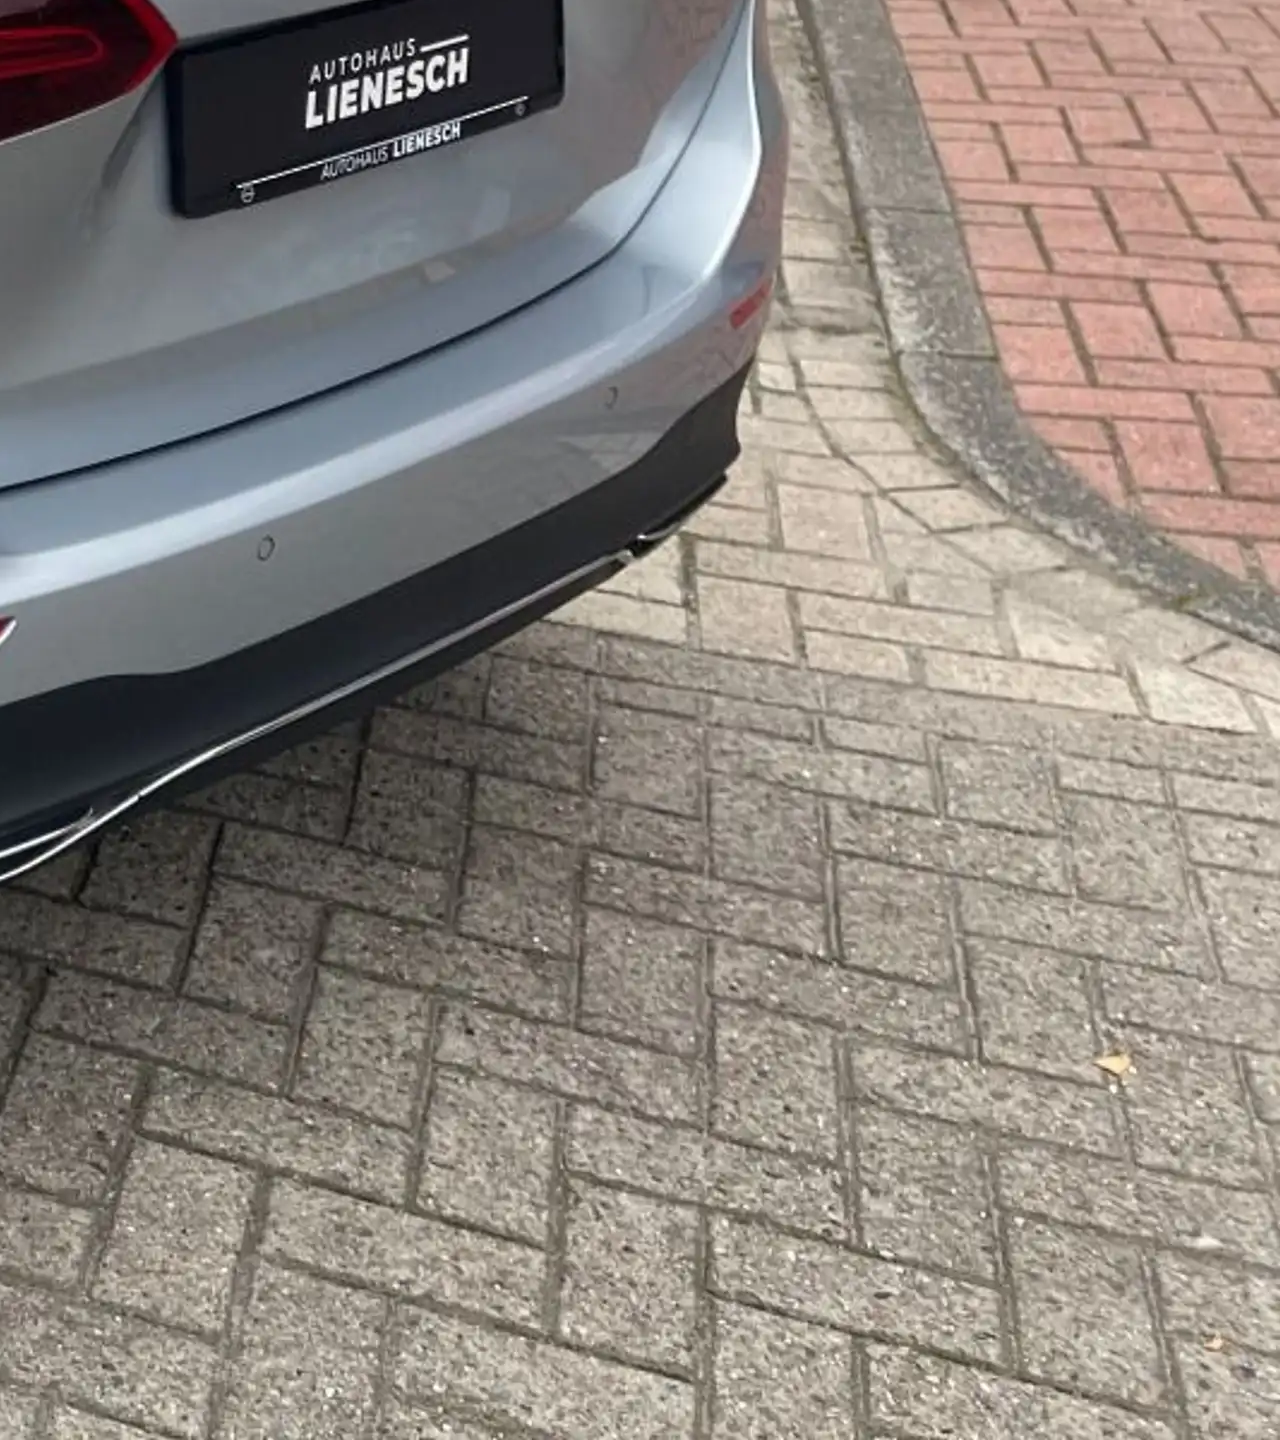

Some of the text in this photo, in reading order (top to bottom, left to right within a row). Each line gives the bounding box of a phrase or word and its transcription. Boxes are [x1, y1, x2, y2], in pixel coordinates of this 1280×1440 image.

[304, 47, 469, 130] LIENESCH
[308, 38, 417, 85] AUTOHAUS
[320, 121, 461, 181] AUTOHAUS LIENESCH
